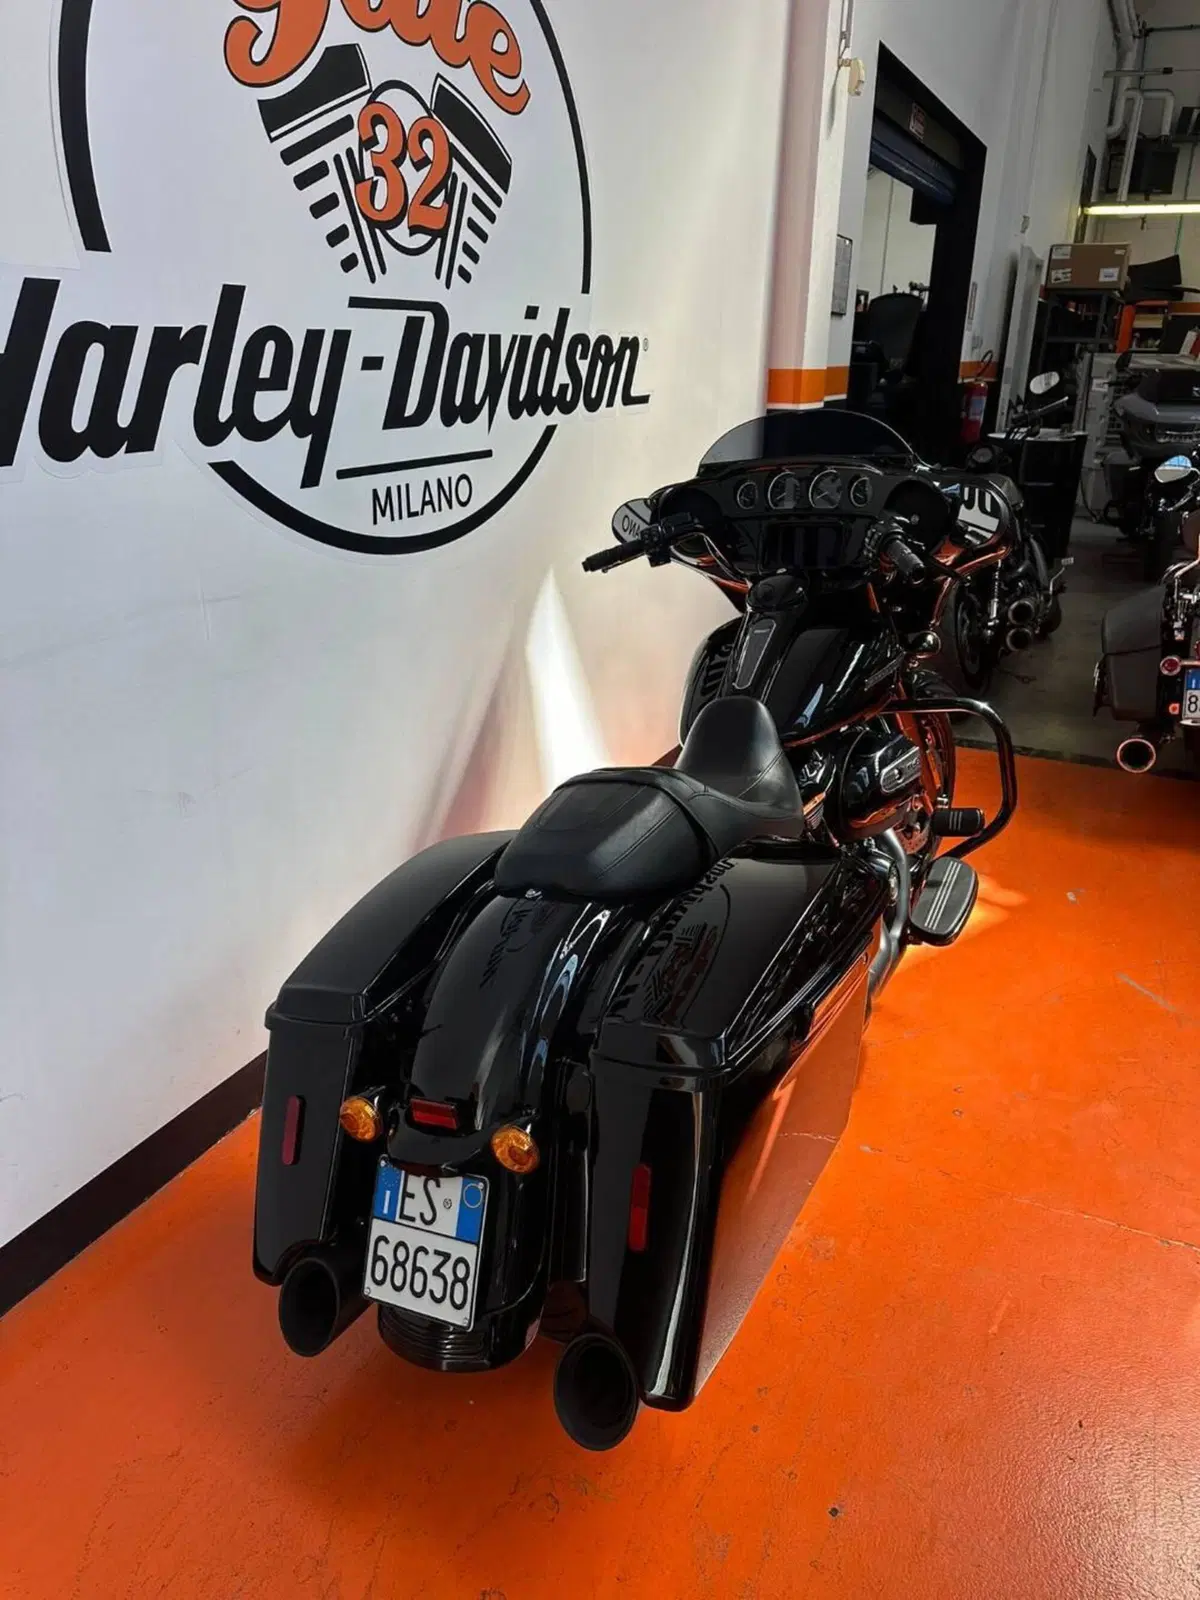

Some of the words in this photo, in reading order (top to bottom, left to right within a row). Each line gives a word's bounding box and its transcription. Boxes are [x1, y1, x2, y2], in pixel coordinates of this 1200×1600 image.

[355, 101, 453, 237] 32
[372, 473, 472, 525] MILANO
[398, 1174, 441, 1226] ES
[370, 1235, 471, 1311] 68638
